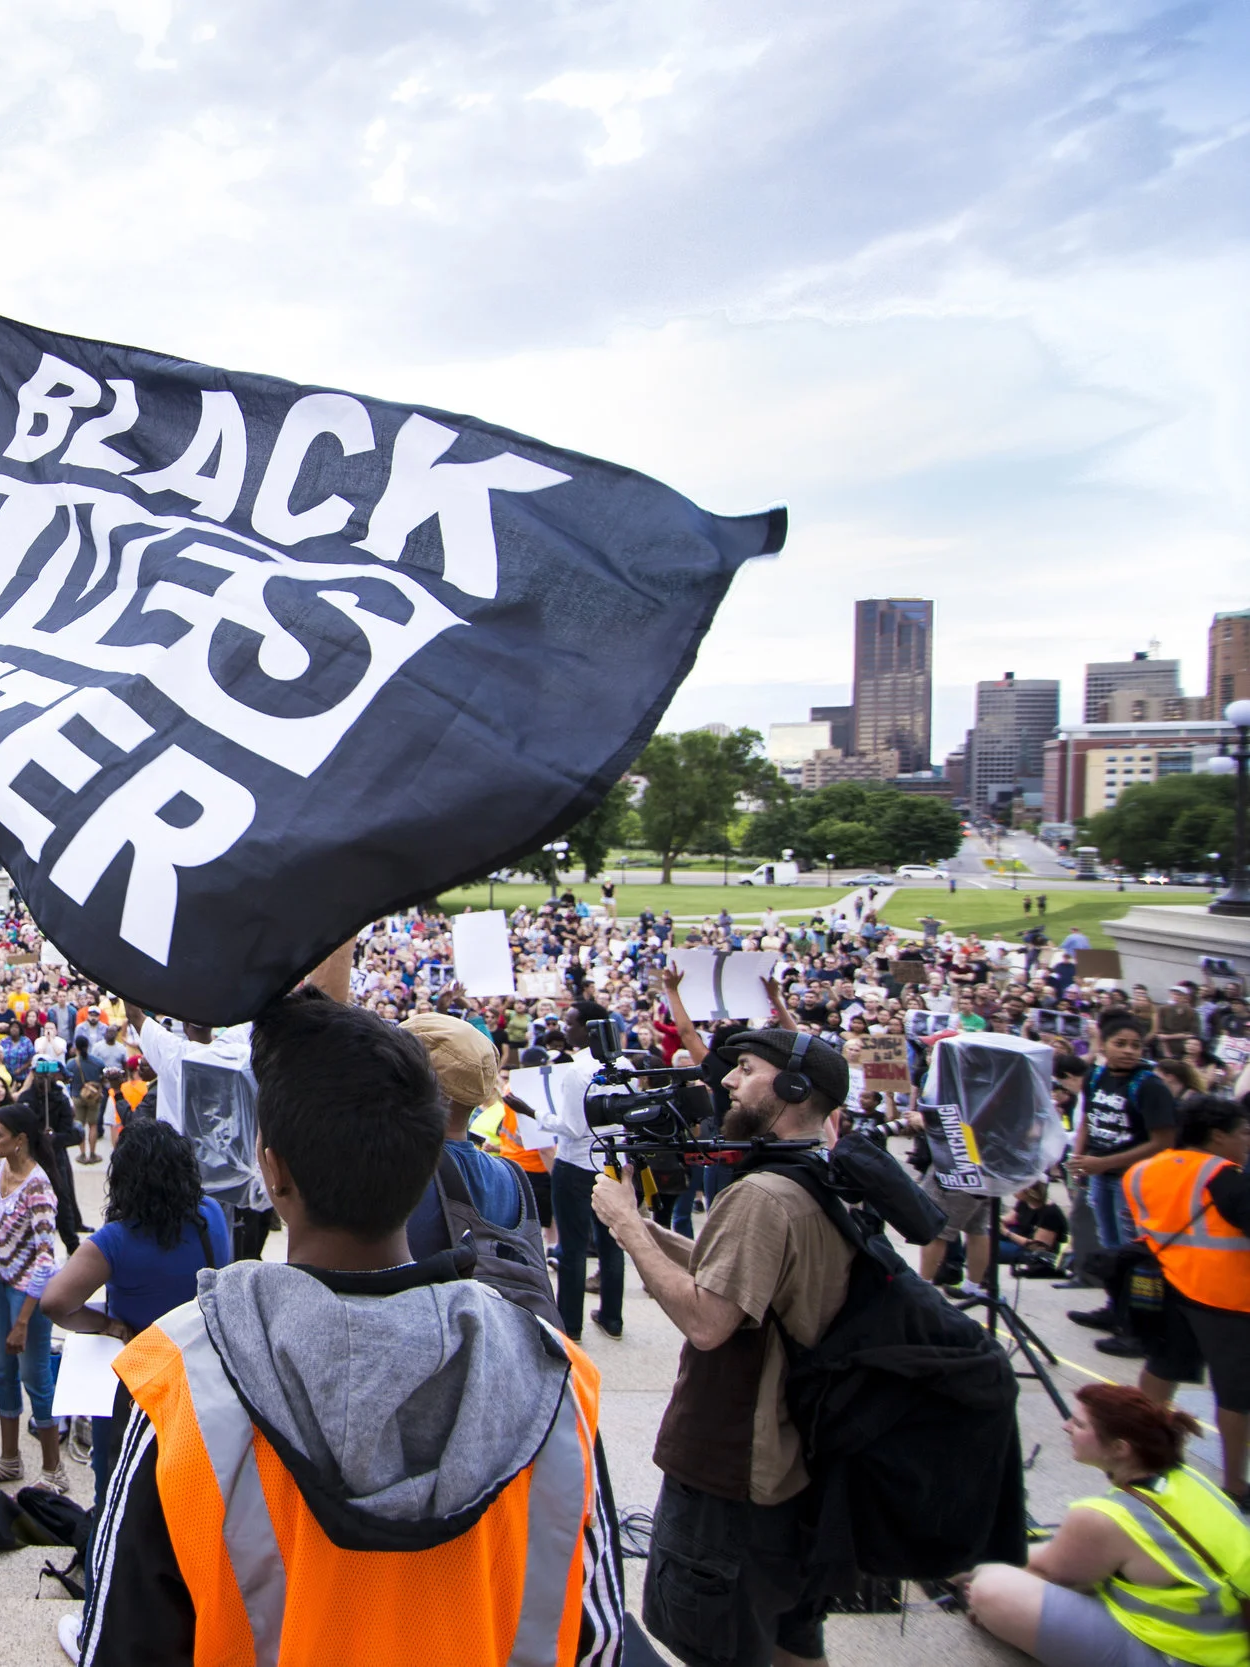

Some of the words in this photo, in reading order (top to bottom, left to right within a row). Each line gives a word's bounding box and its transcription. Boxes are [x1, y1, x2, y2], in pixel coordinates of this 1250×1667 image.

[2, 352, 574, 600] BLACK
[938, 1105, 978, 1175] WATCHING
[939, 1174, 980, 1187] ORLD
